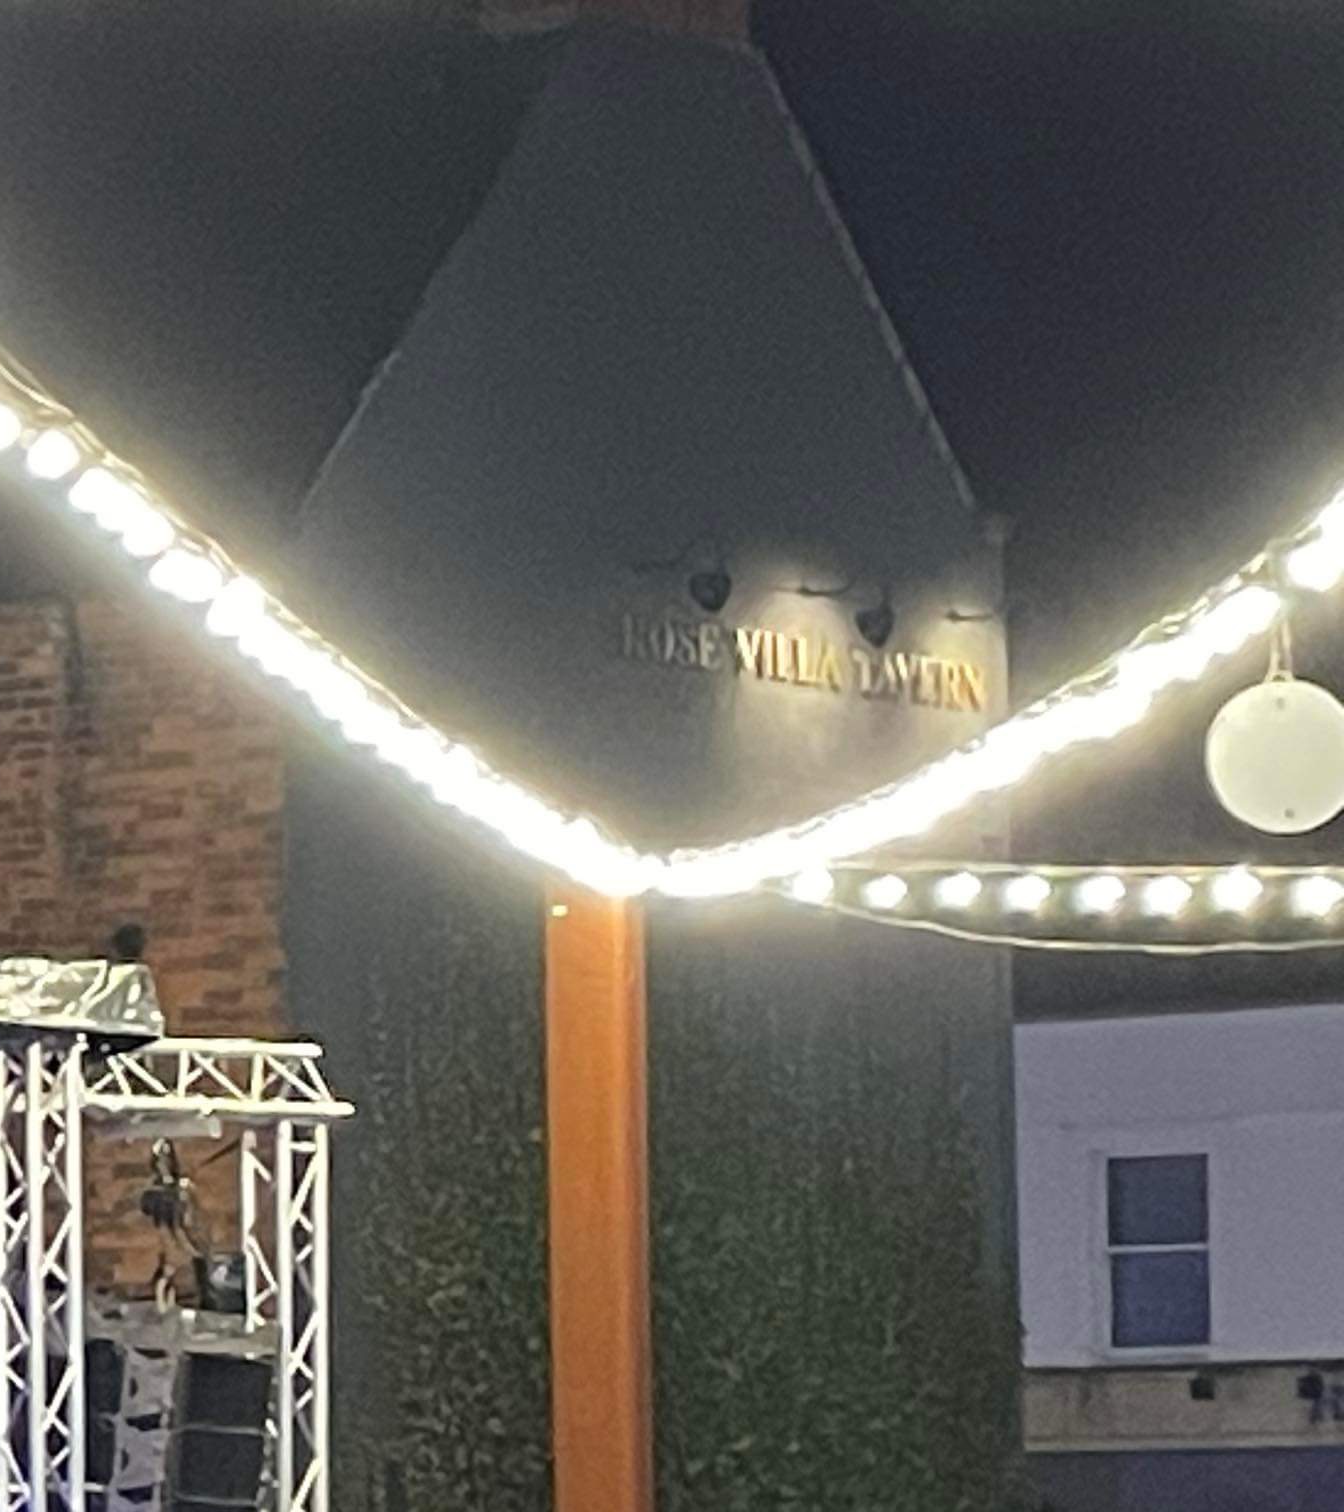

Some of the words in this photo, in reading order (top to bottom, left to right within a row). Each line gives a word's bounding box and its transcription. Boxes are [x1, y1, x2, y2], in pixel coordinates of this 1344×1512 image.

[622, 612, 722, 671] ROSE
[735, 627, 841, 693] VILLA
[852, 650, 986, 713] TAVERN
